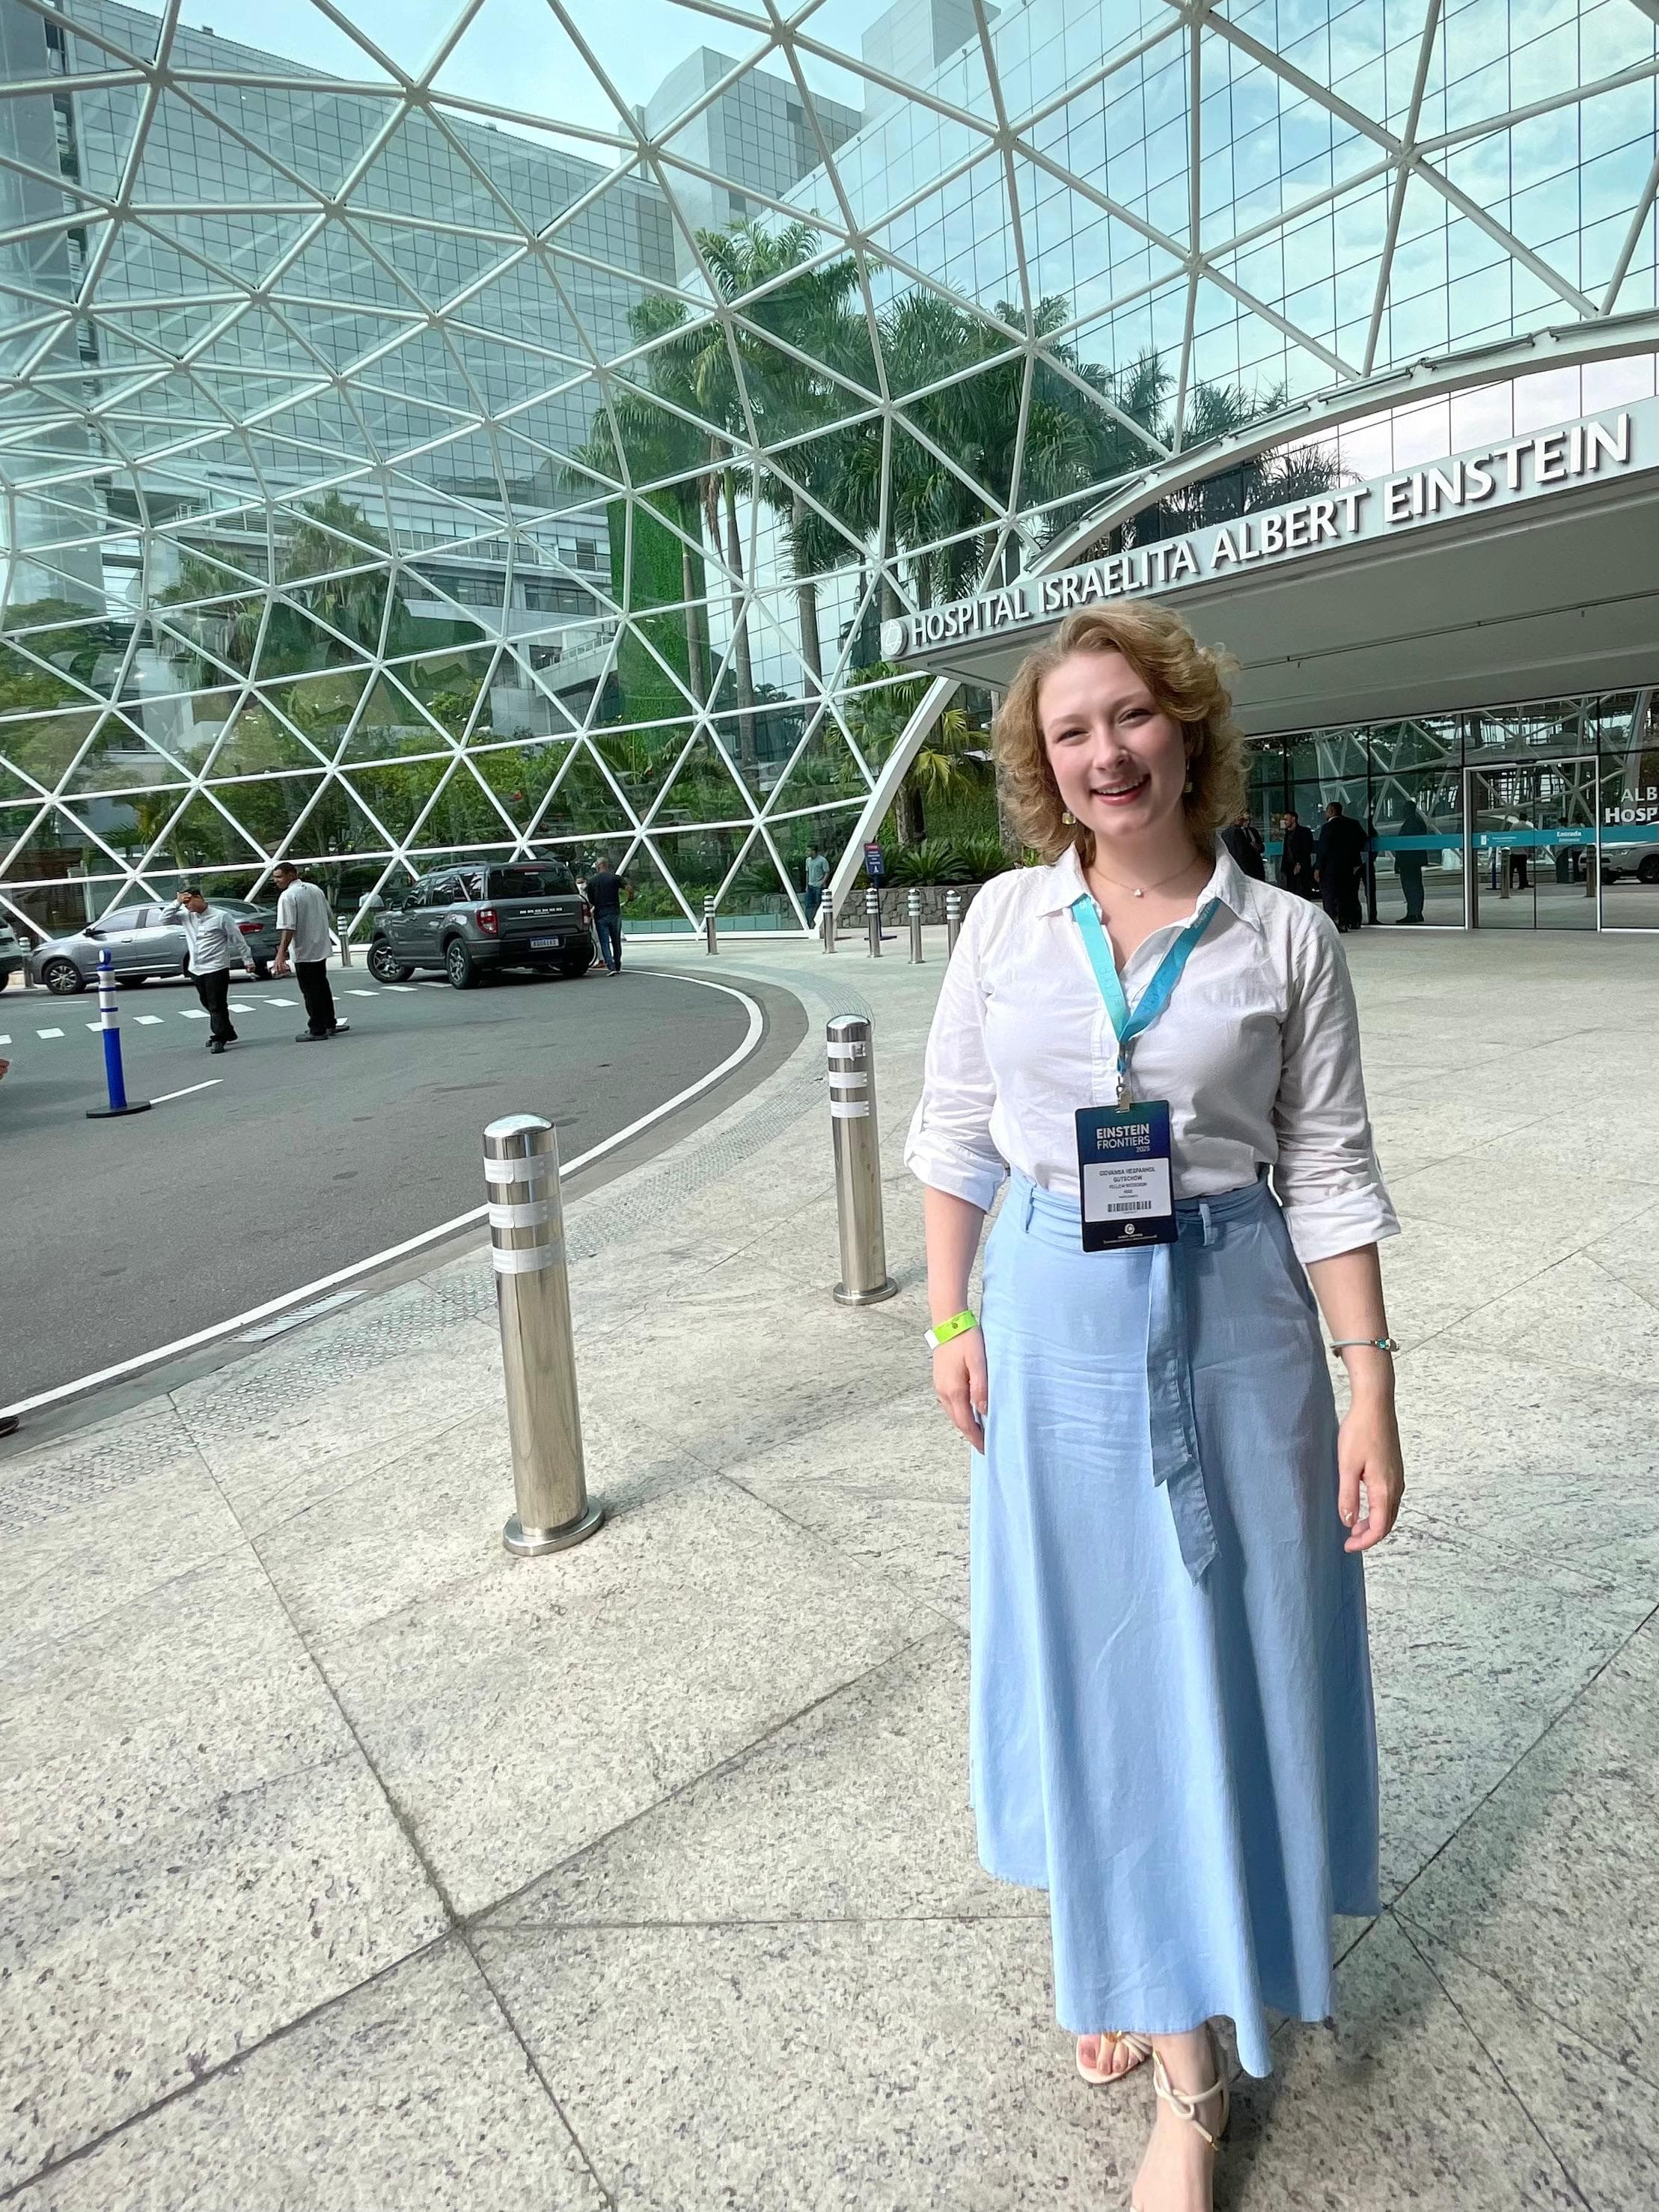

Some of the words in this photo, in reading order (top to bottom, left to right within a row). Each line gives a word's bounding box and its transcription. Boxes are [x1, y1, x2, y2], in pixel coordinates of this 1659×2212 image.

[911, 589, 1029, 646] HOSPITAL
[1038, 540, 1197, 613] ISRAELITA
[1209, 487, 1370, 568] ALBERT
[1384, 413, 1630, 523] EINSTEIN
[1621, 786, 1658, 802] ALB
[1604, 807, 1658, 823] HOSP
[1096, 1123, 1149, 1139] EINSTEIN
[1097, 1135, 1150, 1149] FRONTIERS
